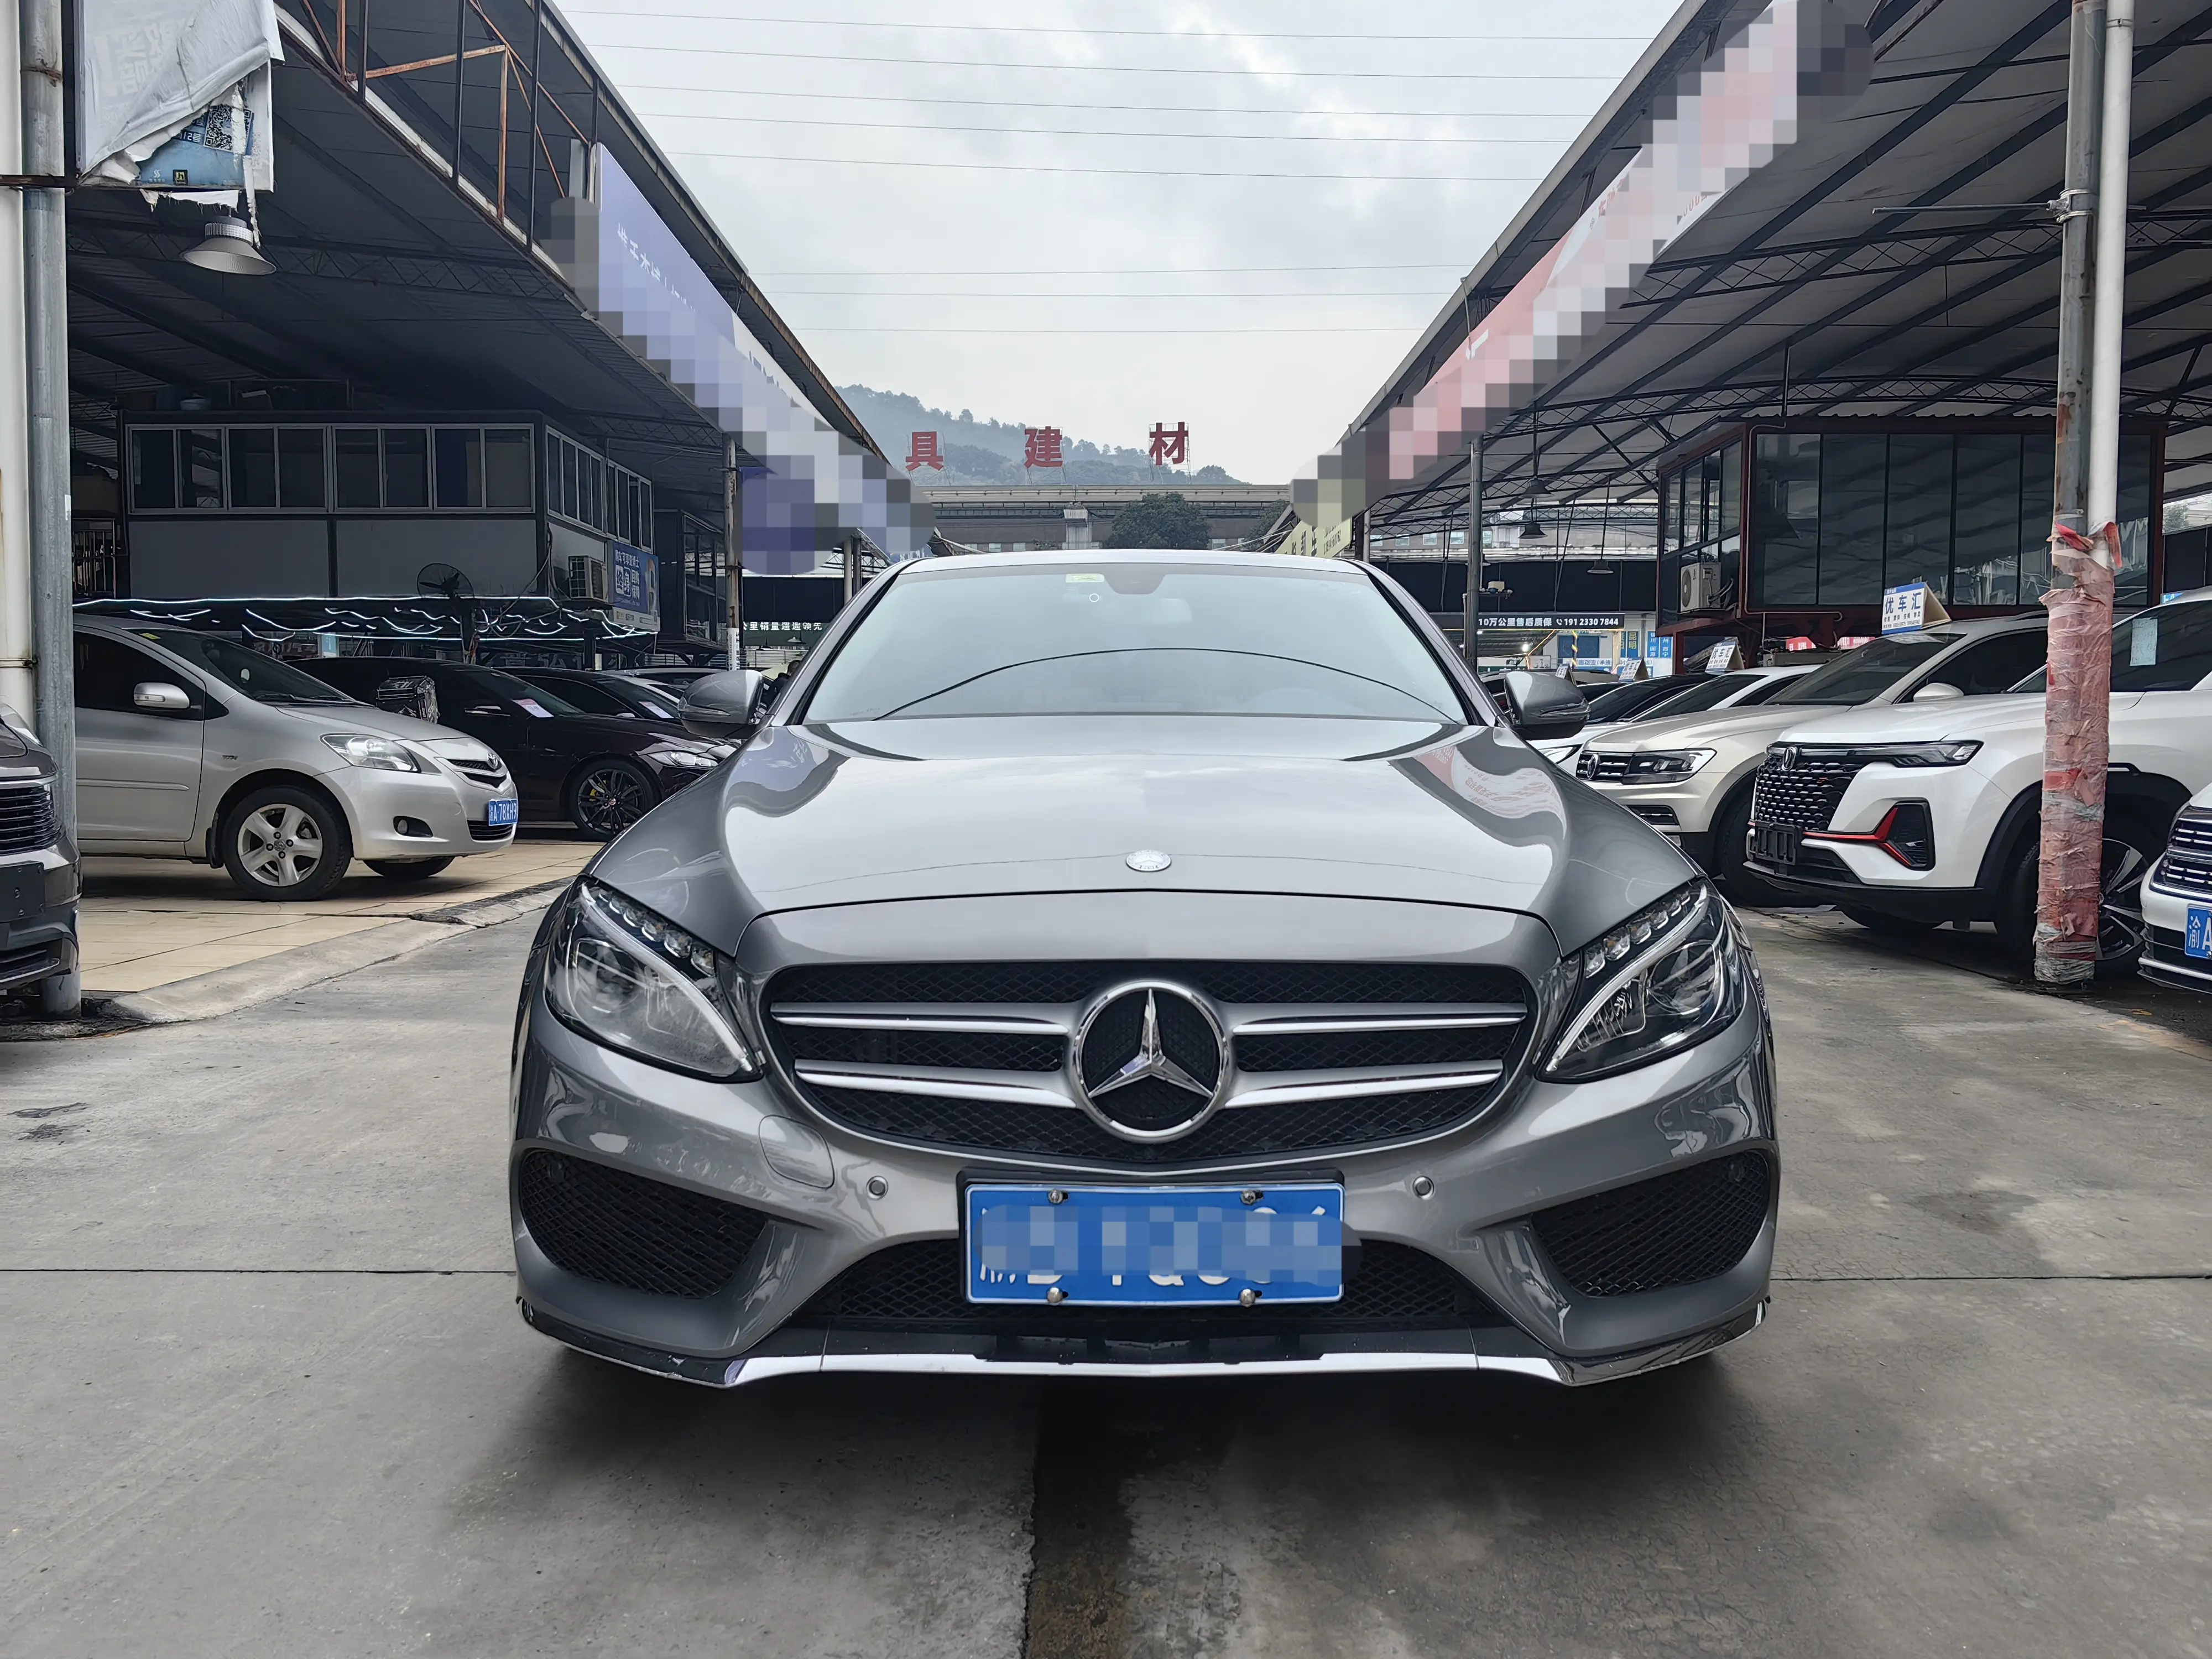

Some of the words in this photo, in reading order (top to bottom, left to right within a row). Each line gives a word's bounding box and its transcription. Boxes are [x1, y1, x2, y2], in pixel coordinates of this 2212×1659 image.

[1885, 592, 1922, 615] 优车汇
[1478, 617, 1552, 627] 10万公里售后质保
[2188, 915, 2212, 952] 渝A
